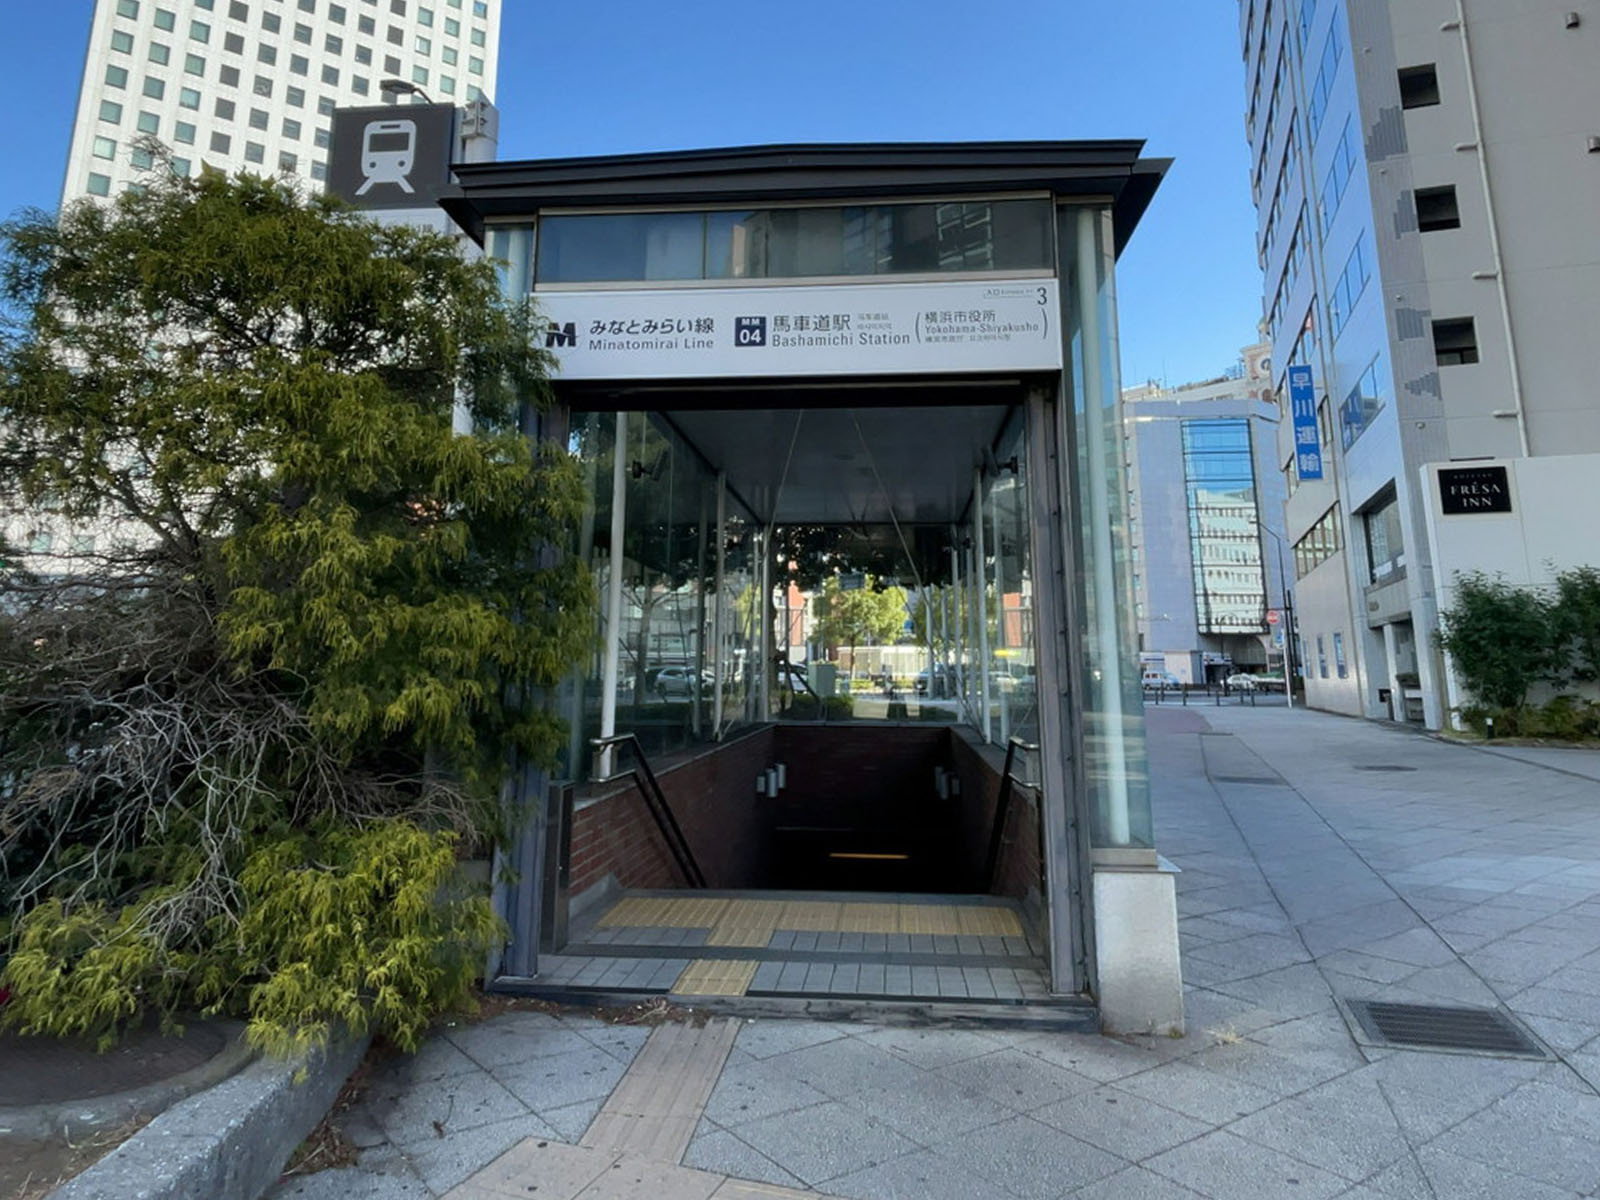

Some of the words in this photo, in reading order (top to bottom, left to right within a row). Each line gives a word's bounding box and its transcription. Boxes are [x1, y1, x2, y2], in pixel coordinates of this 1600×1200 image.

[1036, 286, 1048, 306] 3
[589, 317, 715, 335] みなとみらい線
[772, 314, 851, 332] 馬車道駅
[589, 339, 679, 351] Minatomirai
[684, 338, 714, 349] Line
[739, 328, 762, 344] 04
[772, 334, 854, 347] Bashamichi
[859, 332, 911, 345] Station
[1292, 372, 1320, 473] 早川運輸
[1462, 497, 1492, 508] INN
